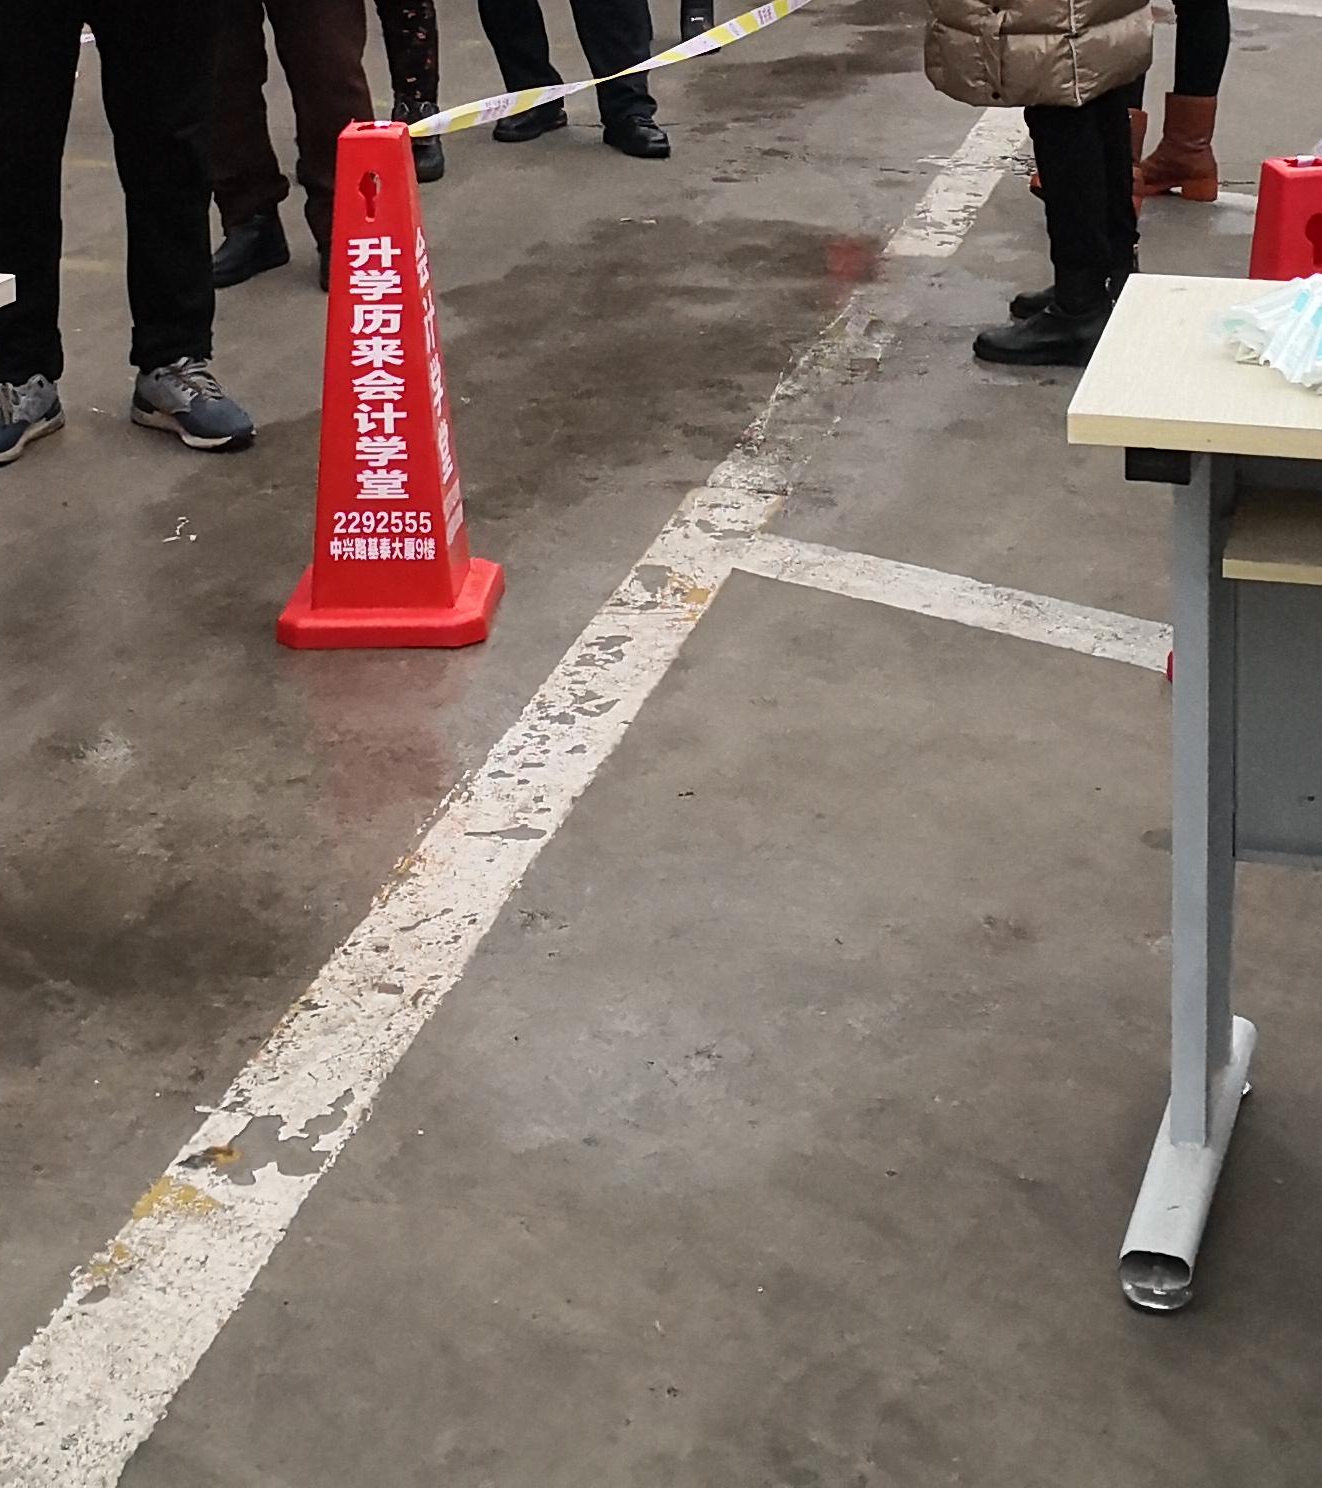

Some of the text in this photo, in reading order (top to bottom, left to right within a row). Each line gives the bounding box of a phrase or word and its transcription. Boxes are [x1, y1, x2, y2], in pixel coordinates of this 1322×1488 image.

[346, 237, 409, 500] 升学历来会计学堂
[333, 511, 432, 534] 2292555
[329, 537, 436, 561] 中兴路基泰大厦9楼
